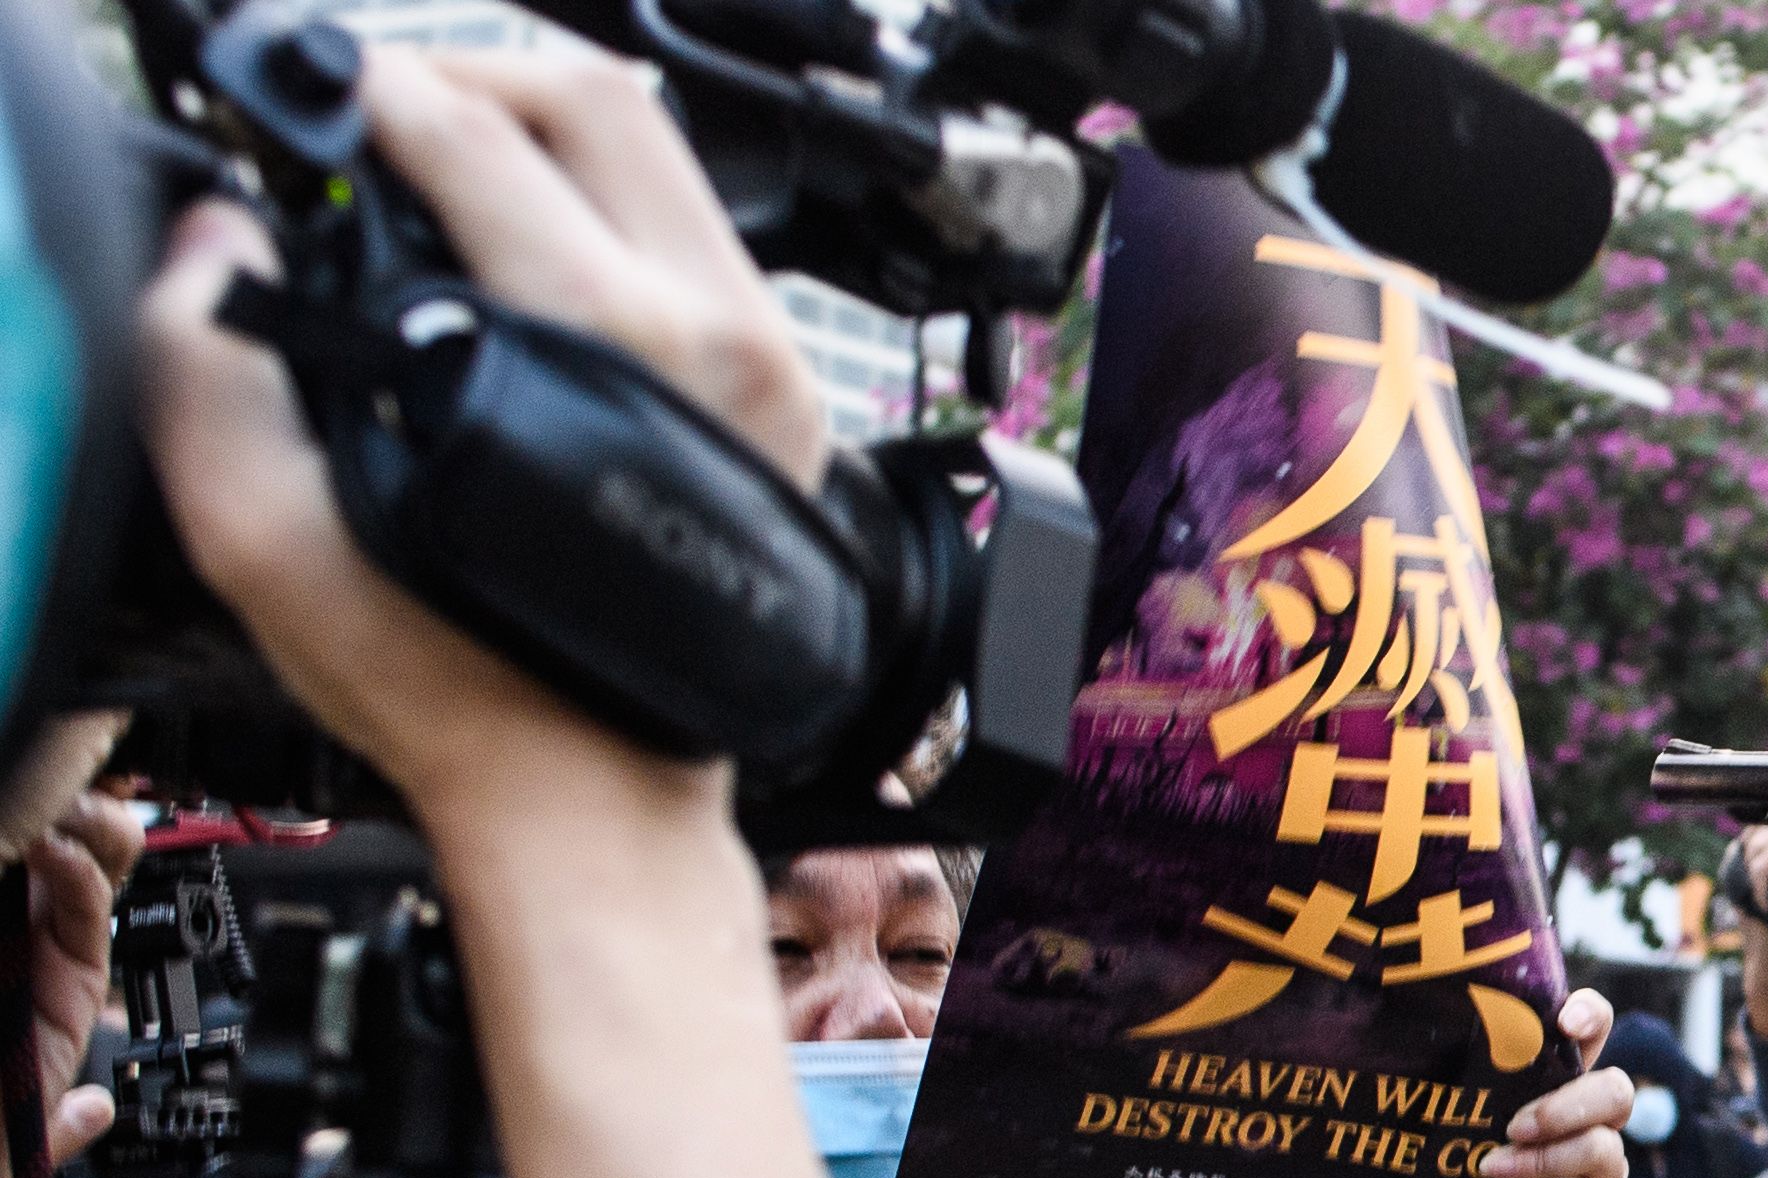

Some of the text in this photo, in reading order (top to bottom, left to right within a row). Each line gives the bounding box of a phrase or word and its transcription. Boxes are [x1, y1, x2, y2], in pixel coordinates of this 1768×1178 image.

[1128, 233, 1546, 1074] 天滅中共
[1148, 1049, 1493, 1128] HEAVEN WILL
[1074, 1092, 1311, 1154] DESTROY
[1325, 1119, 1427, 1176] THE
